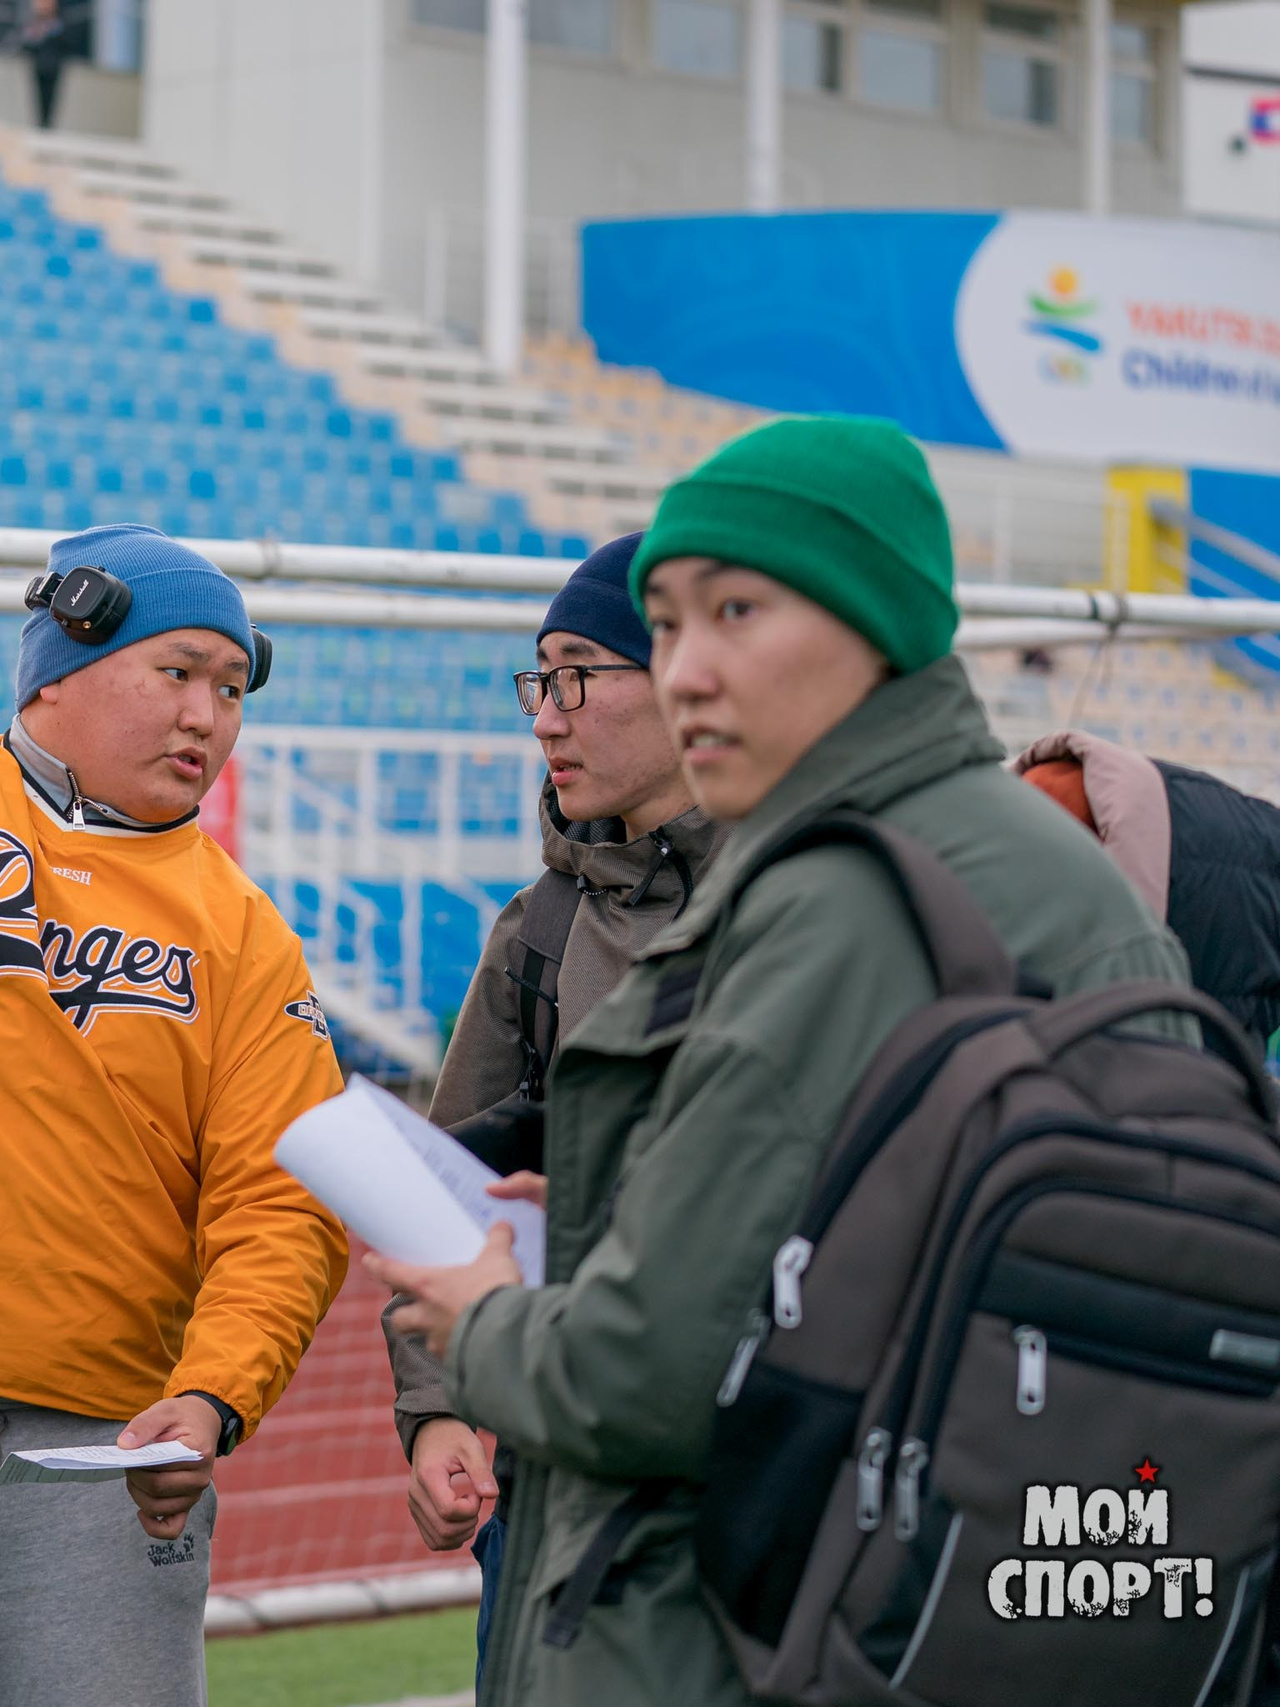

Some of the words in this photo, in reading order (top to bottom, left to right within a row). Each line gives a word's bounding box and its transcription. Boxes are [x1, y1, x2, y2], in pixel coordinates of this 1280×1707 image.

[50, 866, 92, 886] RESH
[147, 1542, 175, 1556] Jack
[148, 1551, 194, 1567] Wolfskin
